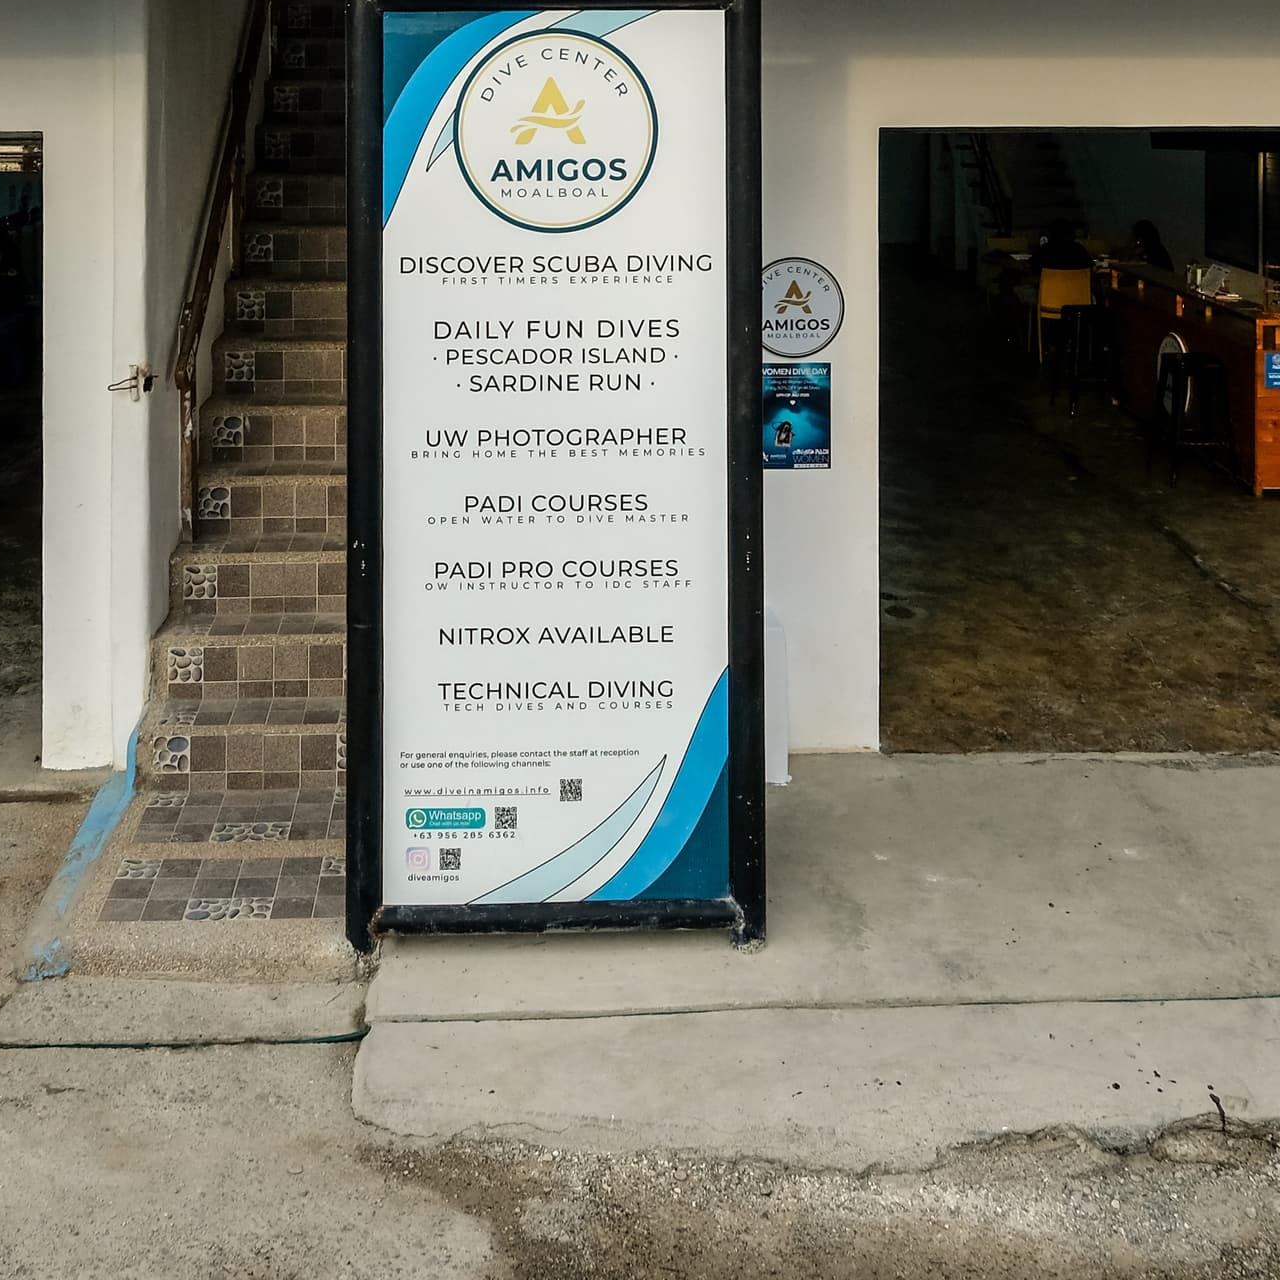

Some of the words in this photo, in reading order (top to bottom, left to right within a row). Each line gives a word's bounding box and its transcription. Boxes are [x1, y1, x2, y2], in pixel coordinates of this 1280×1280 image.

[480, 55, 529, 104] DIVE
[541, 47, 630, 98] CENTER
[491, 159, 627, 181] AMIGOS
[501, 188, 608, 198] MOALBOAL
[400, 257, 523, 273] DISCOVER
[533, 256, 617, 273] SCUBA
[628, 255, 711, 272] DIVING
[443, 277, 487, 285] FIRST
[498, 277, 558, 285] TIMERS
[570, 275, 672, 284] EXPERIENCE
[787, 266, 830, 293] CENTER
[435, 321, 514, 339] DAILY
[528, 320, 582, 339] FUN
[598, 319, 679, 338] DIVES
[762, 319, 830, 331] AMIGOS
[447, 349, 572, 365] PESCADOR
[582, 348, 665, 363] ISLAND
[792, 367, 811, 376] DIVE
[811, 367, 828, 376] DAY
[470, 375, 579, 392] SARDINE
[590, 374, 640, 391] RUN
[427, 430, 468, 447] UW
[479, 428, 685, 446] PHOTOGRAPHER
[473, 450, 516, 458] HOME
[569, 449, 608, 457] BEST
[619, 448, 704, 456] MEMORIES
[466, 496, 521, 512] PADI
[532, 494, 647, 512] COURSES
[482, 516, 534, 524] WATER
[577, 515, 613, 523] DIVE
[626, 514, 688, 522] MASTER
[436, 562, 491, 579] PADI
[503, 561, 553, 578] PRO
[563, 560, 678, 577] COURSES
[425, 583, 448, 591] OW
[460, 581, 563, 590] INSTRUCTOR
[575, 581, 593, 589] TO
[606, 581, 631, 589] IDC
[643, 580, 691, 588] STAFF
[440, 628, 529, 645] NITROX
[538, 626, 673, 644] AVAILABLE
[438, 682, 579, 700] TECHNICAL
[589, 681, 672, 698] DIVING
[496, 703, 543, 711] DIVES
[555, 702, 587, 710] AND
[599, 701, 672, 709] COURSES
[400, 751, 414, 759] For
[415, 751, 447, 760] general
[448, 751, 490, 760] enquiries,
[490, 750, 518, 759] please
[519, 749, 552, 758] contact
[553, 749, 568, 757] the
[569, 749, 588, 757] staff
[600, 749, 640, 757] reception
[470, 760, 510, 769] following
[429, 810, 481, 822] Whatsapp
[413, 832, 432, 840] +63
[437, 831, 458, 839] 956
[488, 831, 516, 839] 6362
[407, 873, 460, 882] diveamigos
